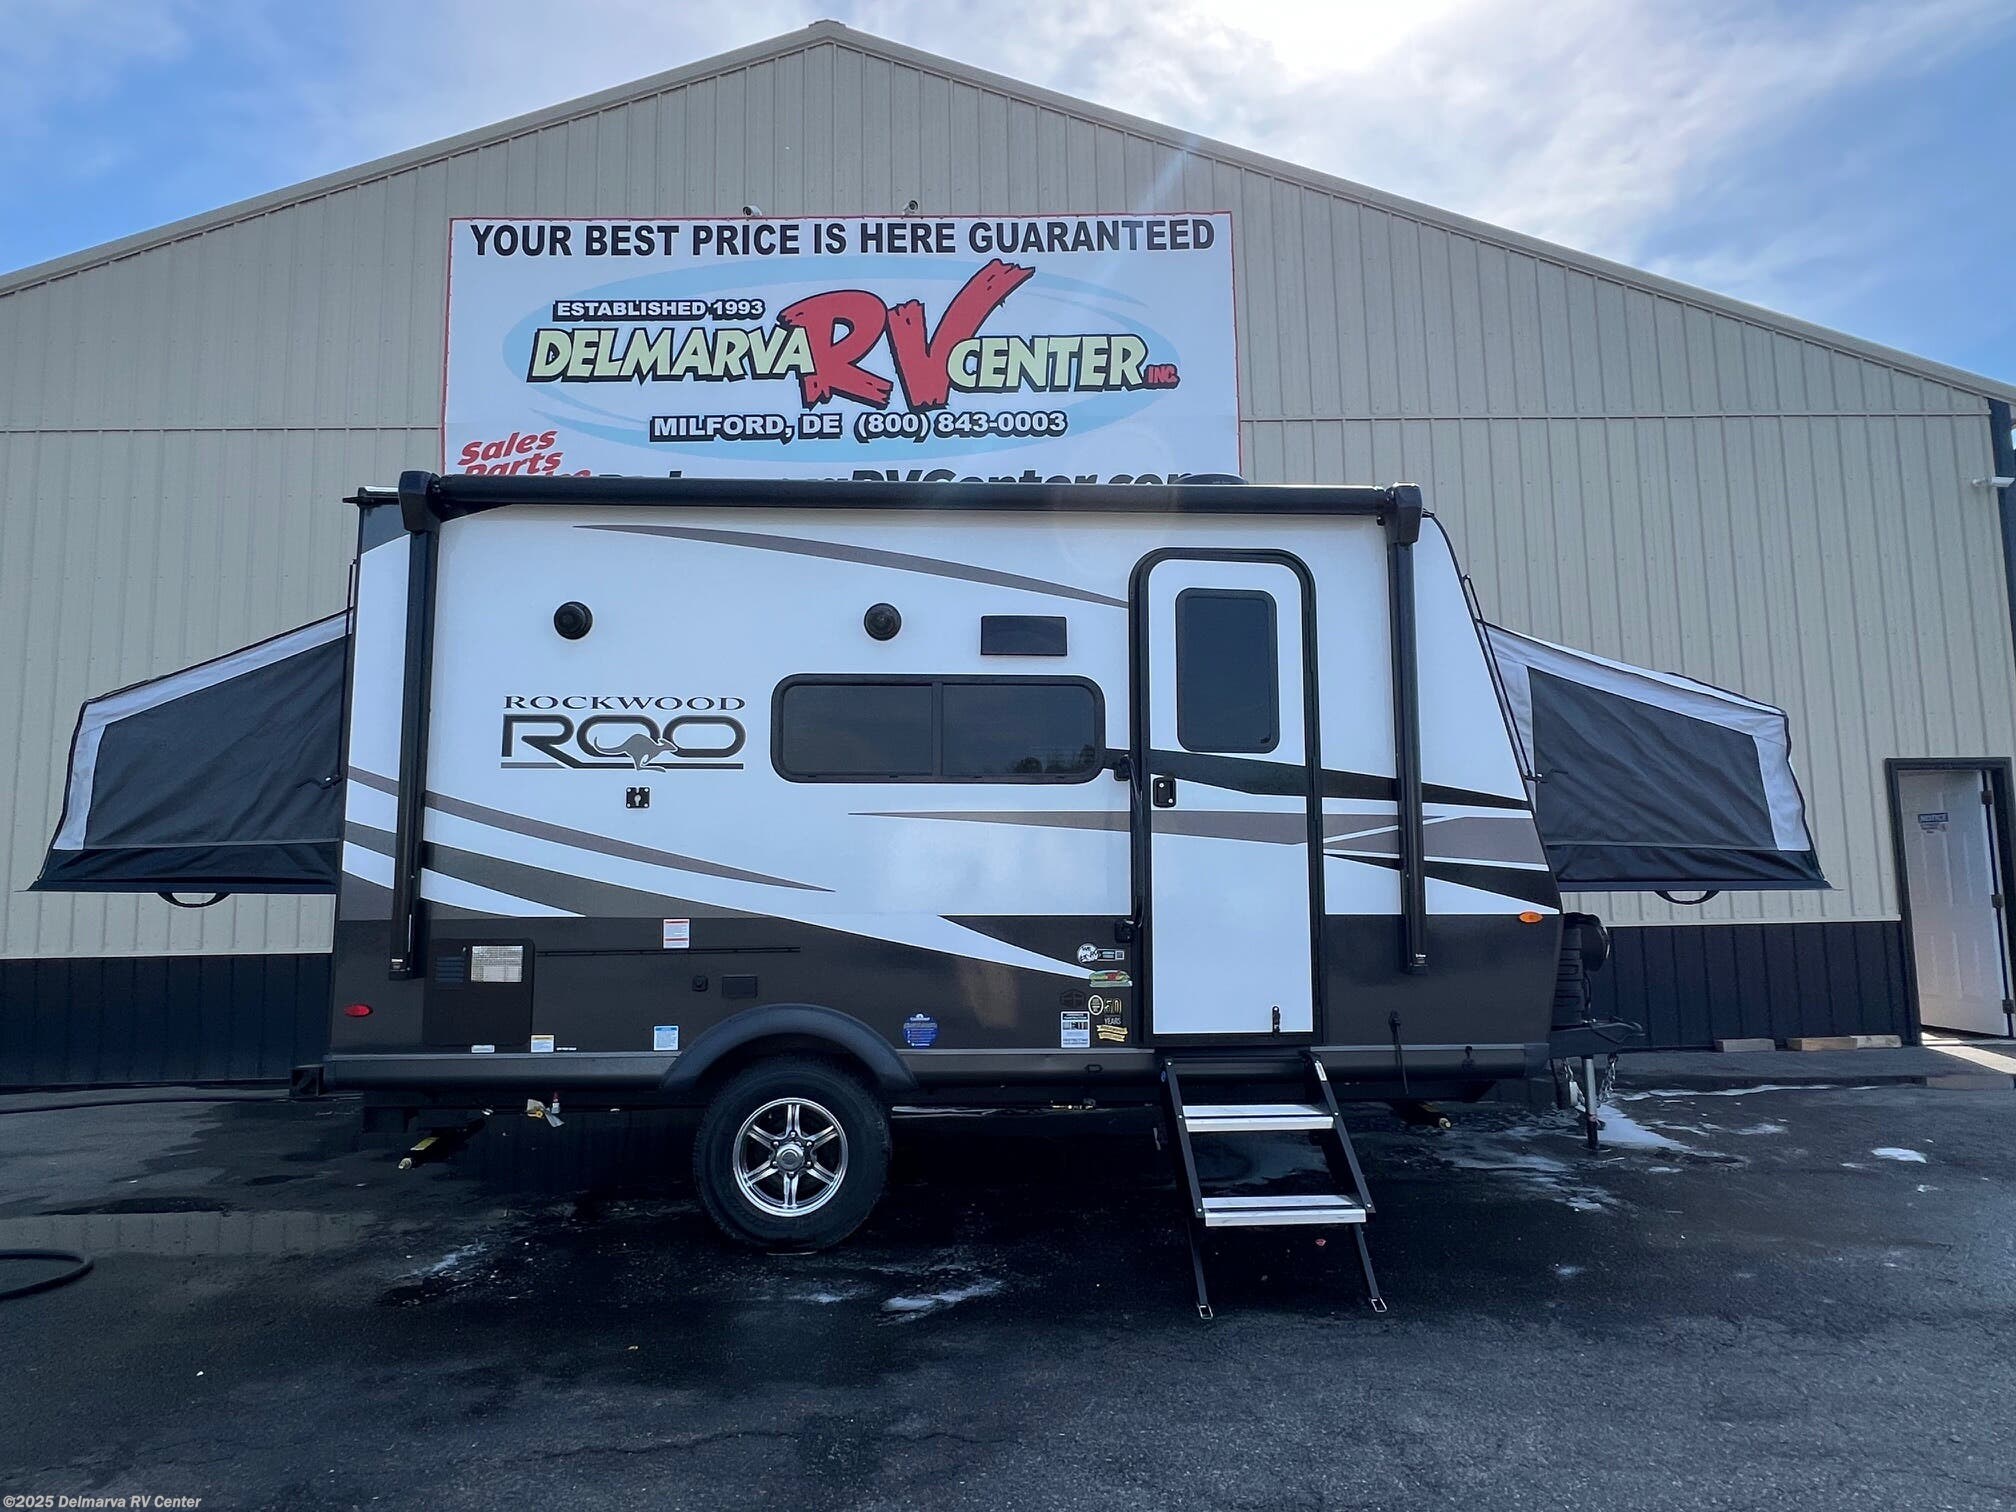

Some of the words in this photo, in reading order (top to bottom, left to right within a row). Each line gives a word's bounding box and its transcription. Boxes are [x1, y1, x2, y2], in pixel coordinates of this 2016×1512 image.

[470, 225, 572, 256] YOUR
[585, 225, 679, 255] BEST
[693, 224, 800, 255] PRICE
[814, 223, 846, 254] IS
[860, 223, 956, 253] HERE
[969, 219, 1215, 253] GUARANTEED
[555, 300, 707, 318] ESTABLISHED
[712, 300, 764, 316] 1993
[529, 327, 816, 382] DELMARVA
[777, 258, 1036, 410] RV
[946, 335, 1148, 391] CENTER
[653, 416, 796, 441] MILFORD,
[802, 414, 842, 435] DE
[857, 413, 929, 438] (800)
[937, 412, 1068, 433] 843-0003
[458, 430, 558, 465] Sales
[503, 695, 746, 710] ROCKWOOD
[501, 714, 746, 769] ROO
[1104, 1017, 1122, 1025] YEARS
